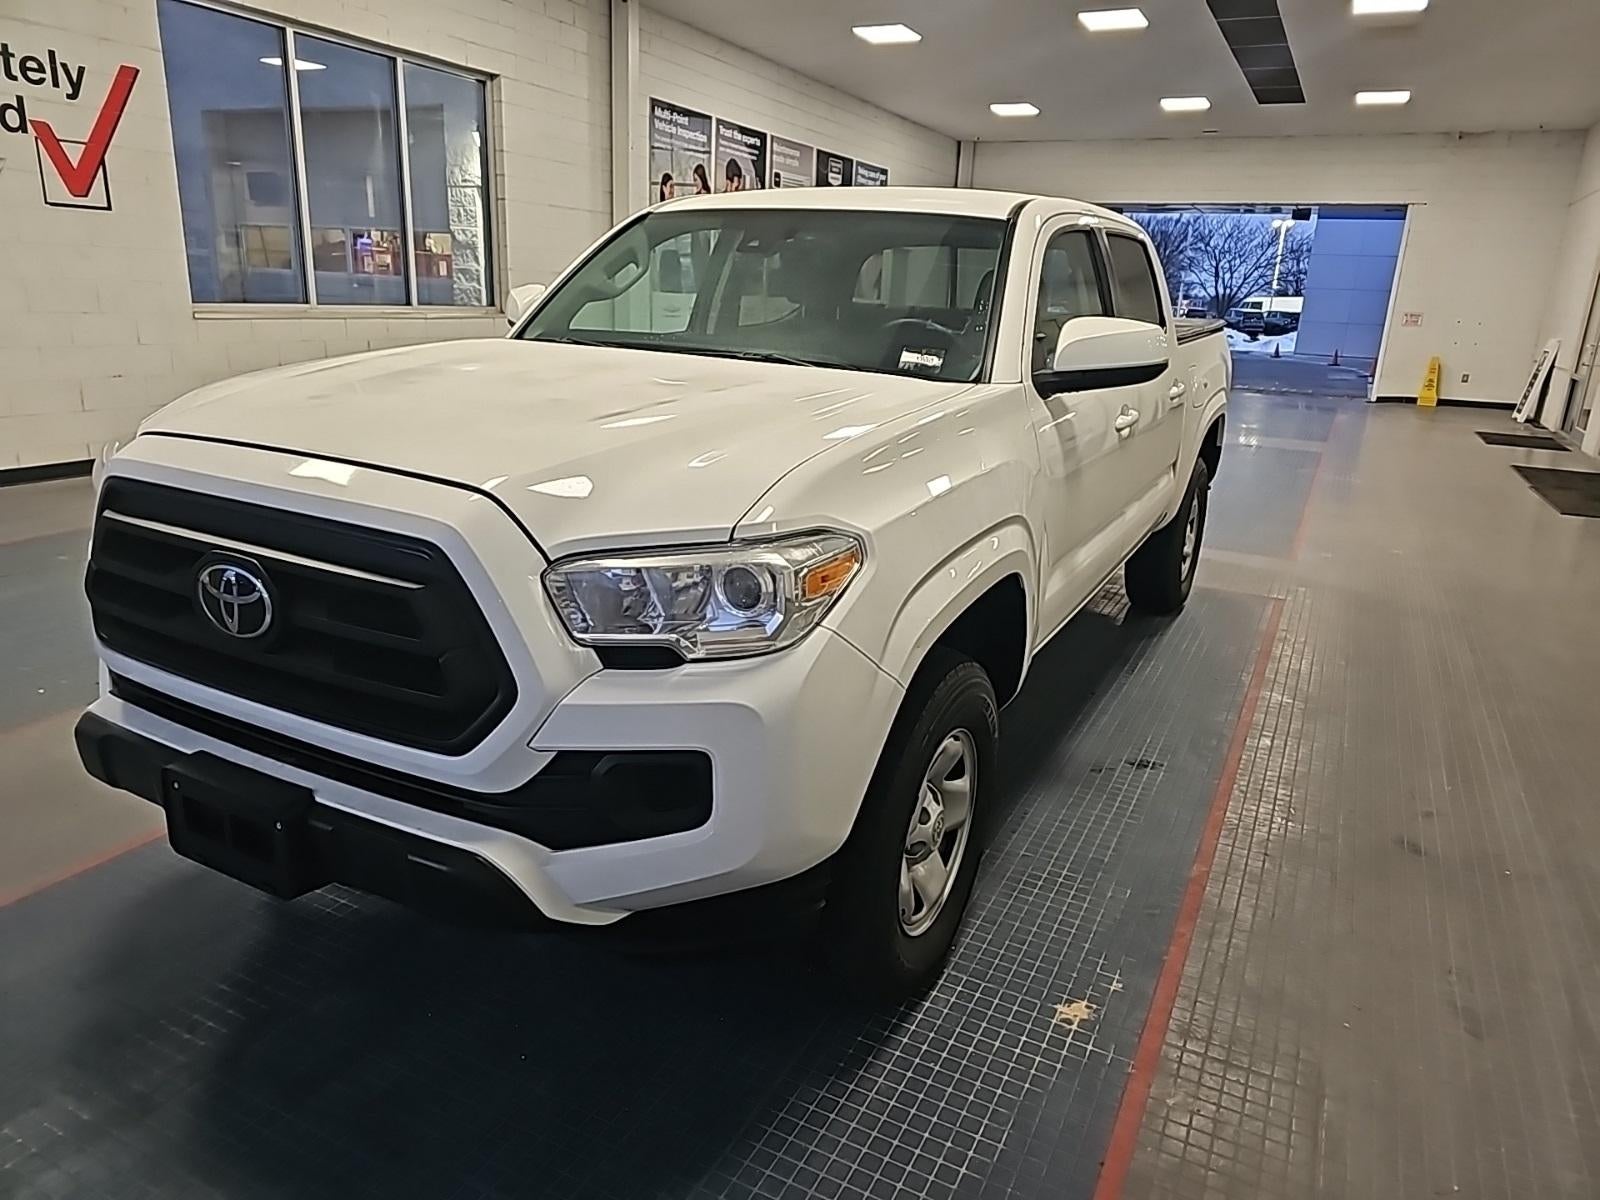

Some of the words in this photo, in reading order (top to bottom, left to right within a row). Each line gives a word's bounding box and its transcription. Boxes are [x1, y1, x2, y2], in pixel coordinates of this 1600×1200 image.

[0, 42, 86, 100] tely
[654, 105, 689, 126] Multi-Point
[654, 118, 677, 135] Vehicle
[677, 125, 708, 143] Inspection
[719, 124, 733, 138] Trust
[733, 129, 742, 140] the
[742, 134, 761, 147] experts
